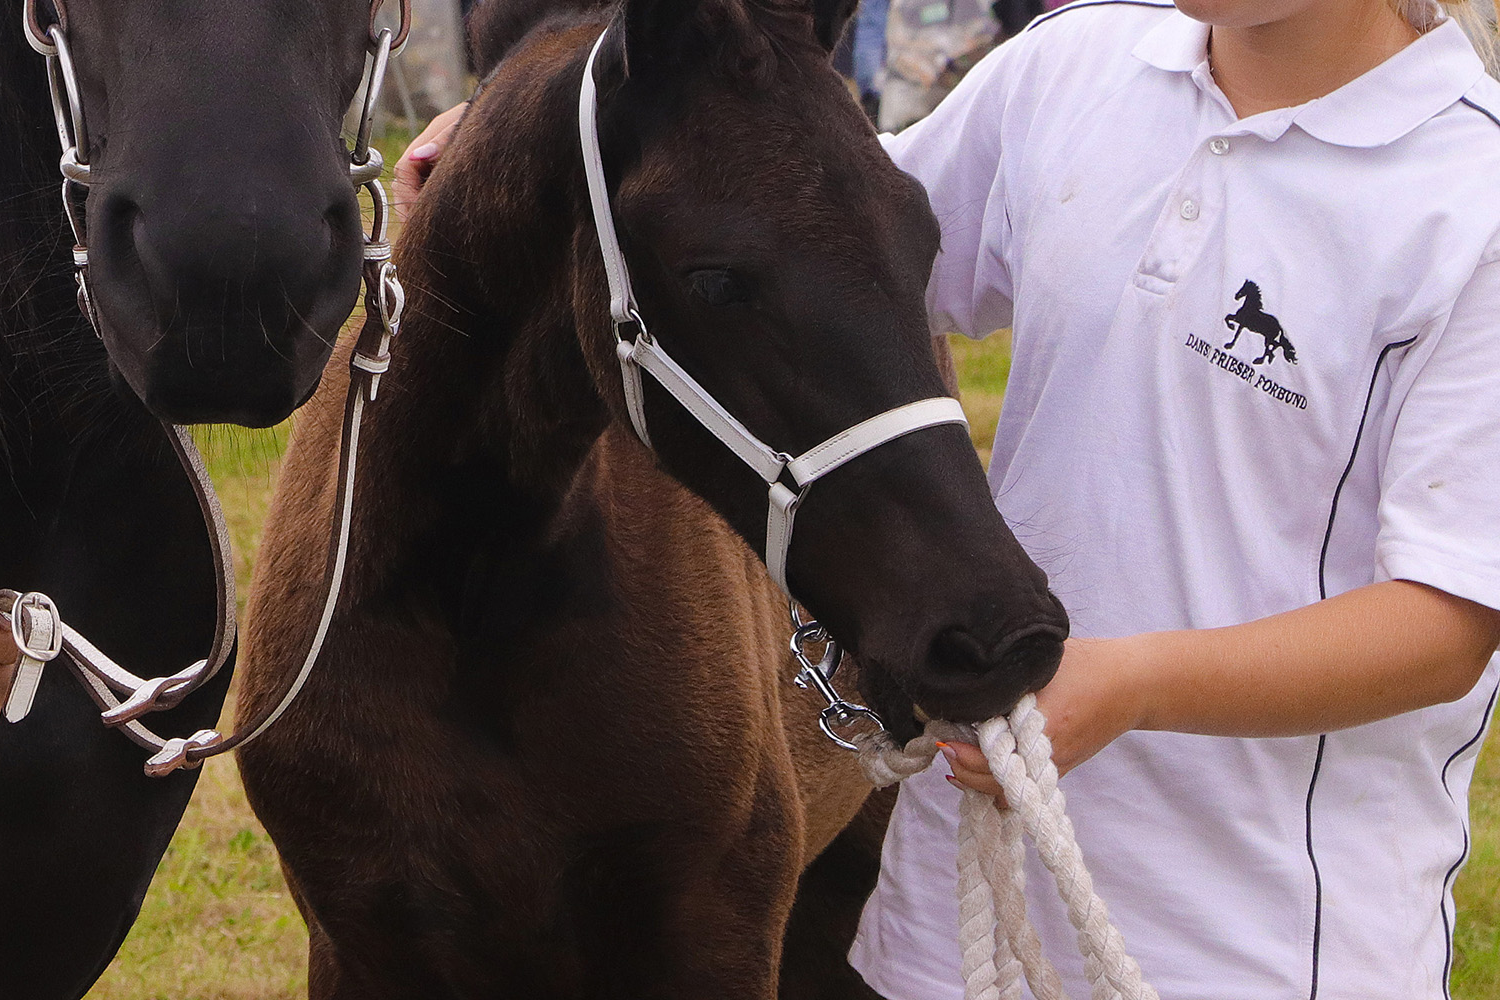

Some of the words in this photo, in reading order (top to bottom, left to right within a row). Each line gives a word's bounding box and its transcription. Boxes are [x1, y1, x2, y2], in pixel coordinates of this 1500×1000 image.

[1185, 333, 1212, 358] DANS
[1209, 348, 1256, 384] FRIESER
[1254, 374, 1308, 410] FORBUND
